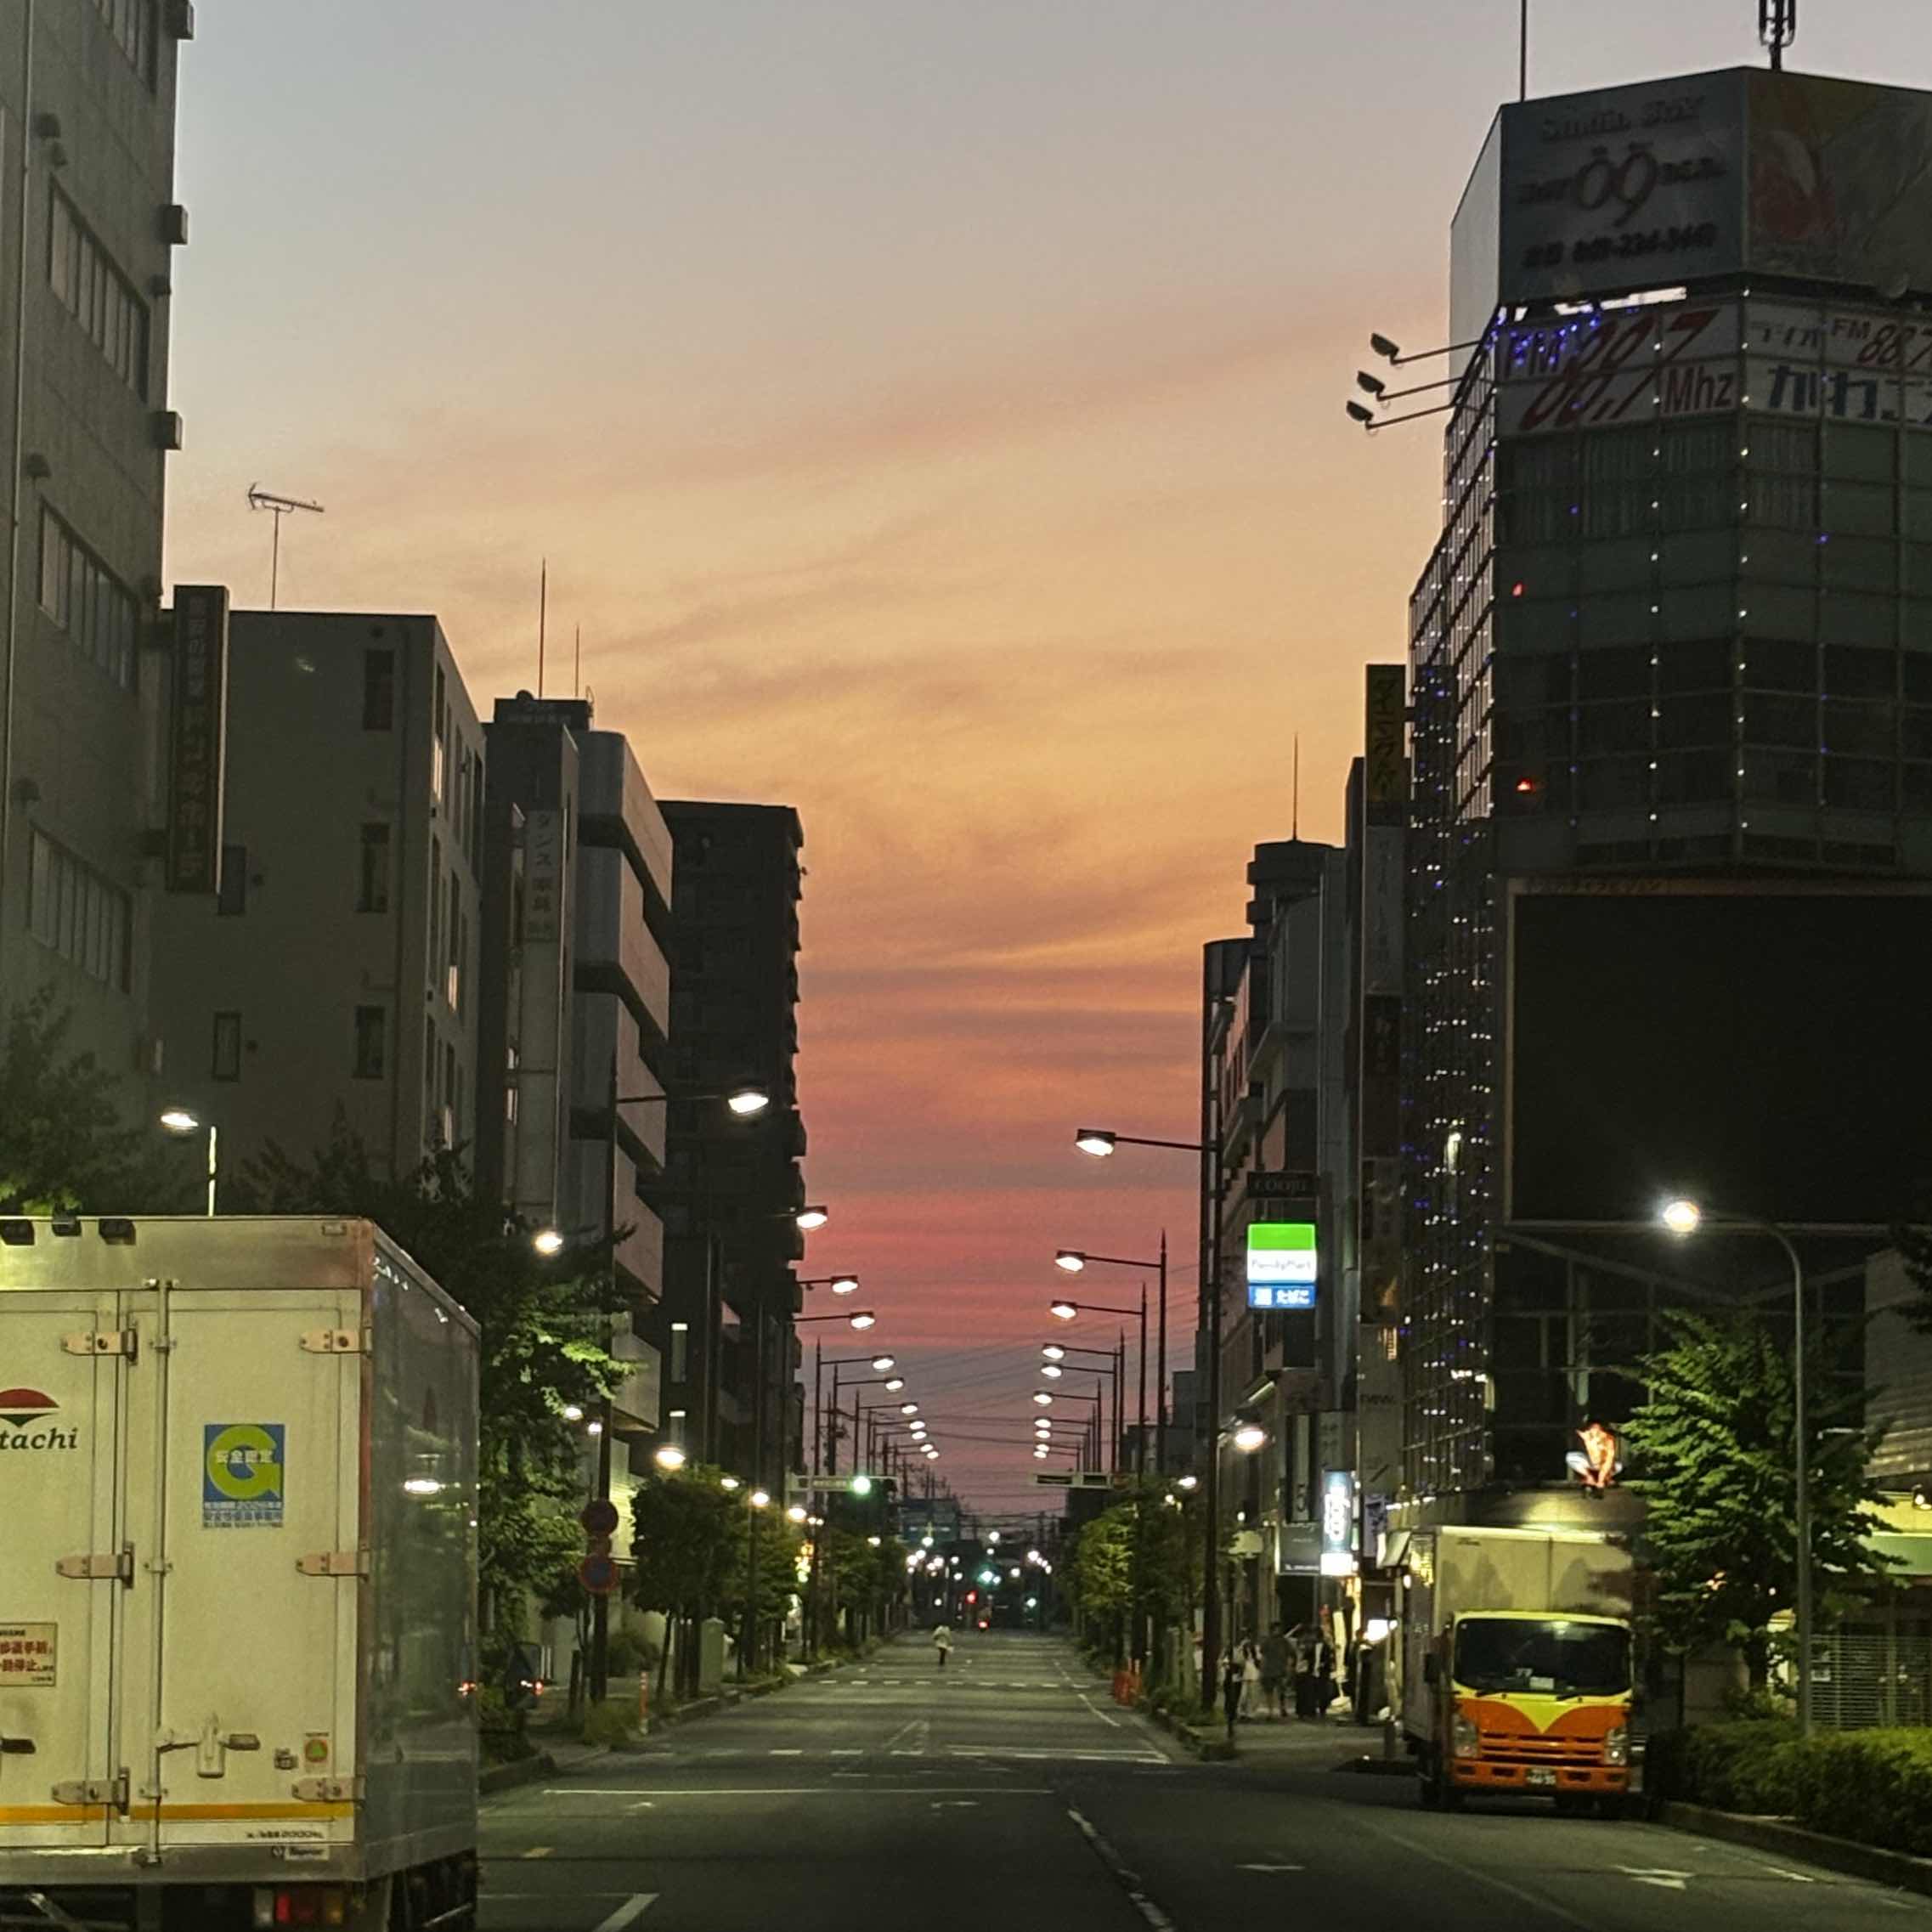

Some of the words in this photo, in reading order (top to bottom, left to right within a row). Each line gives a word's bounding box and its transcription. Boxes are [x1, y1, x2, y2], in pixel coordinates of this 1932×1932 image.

[1832, 318, 1871, 339] FM
[1664, 365, 1733, 414] Mhz
[0, 1427, 77, 1449] tachi
